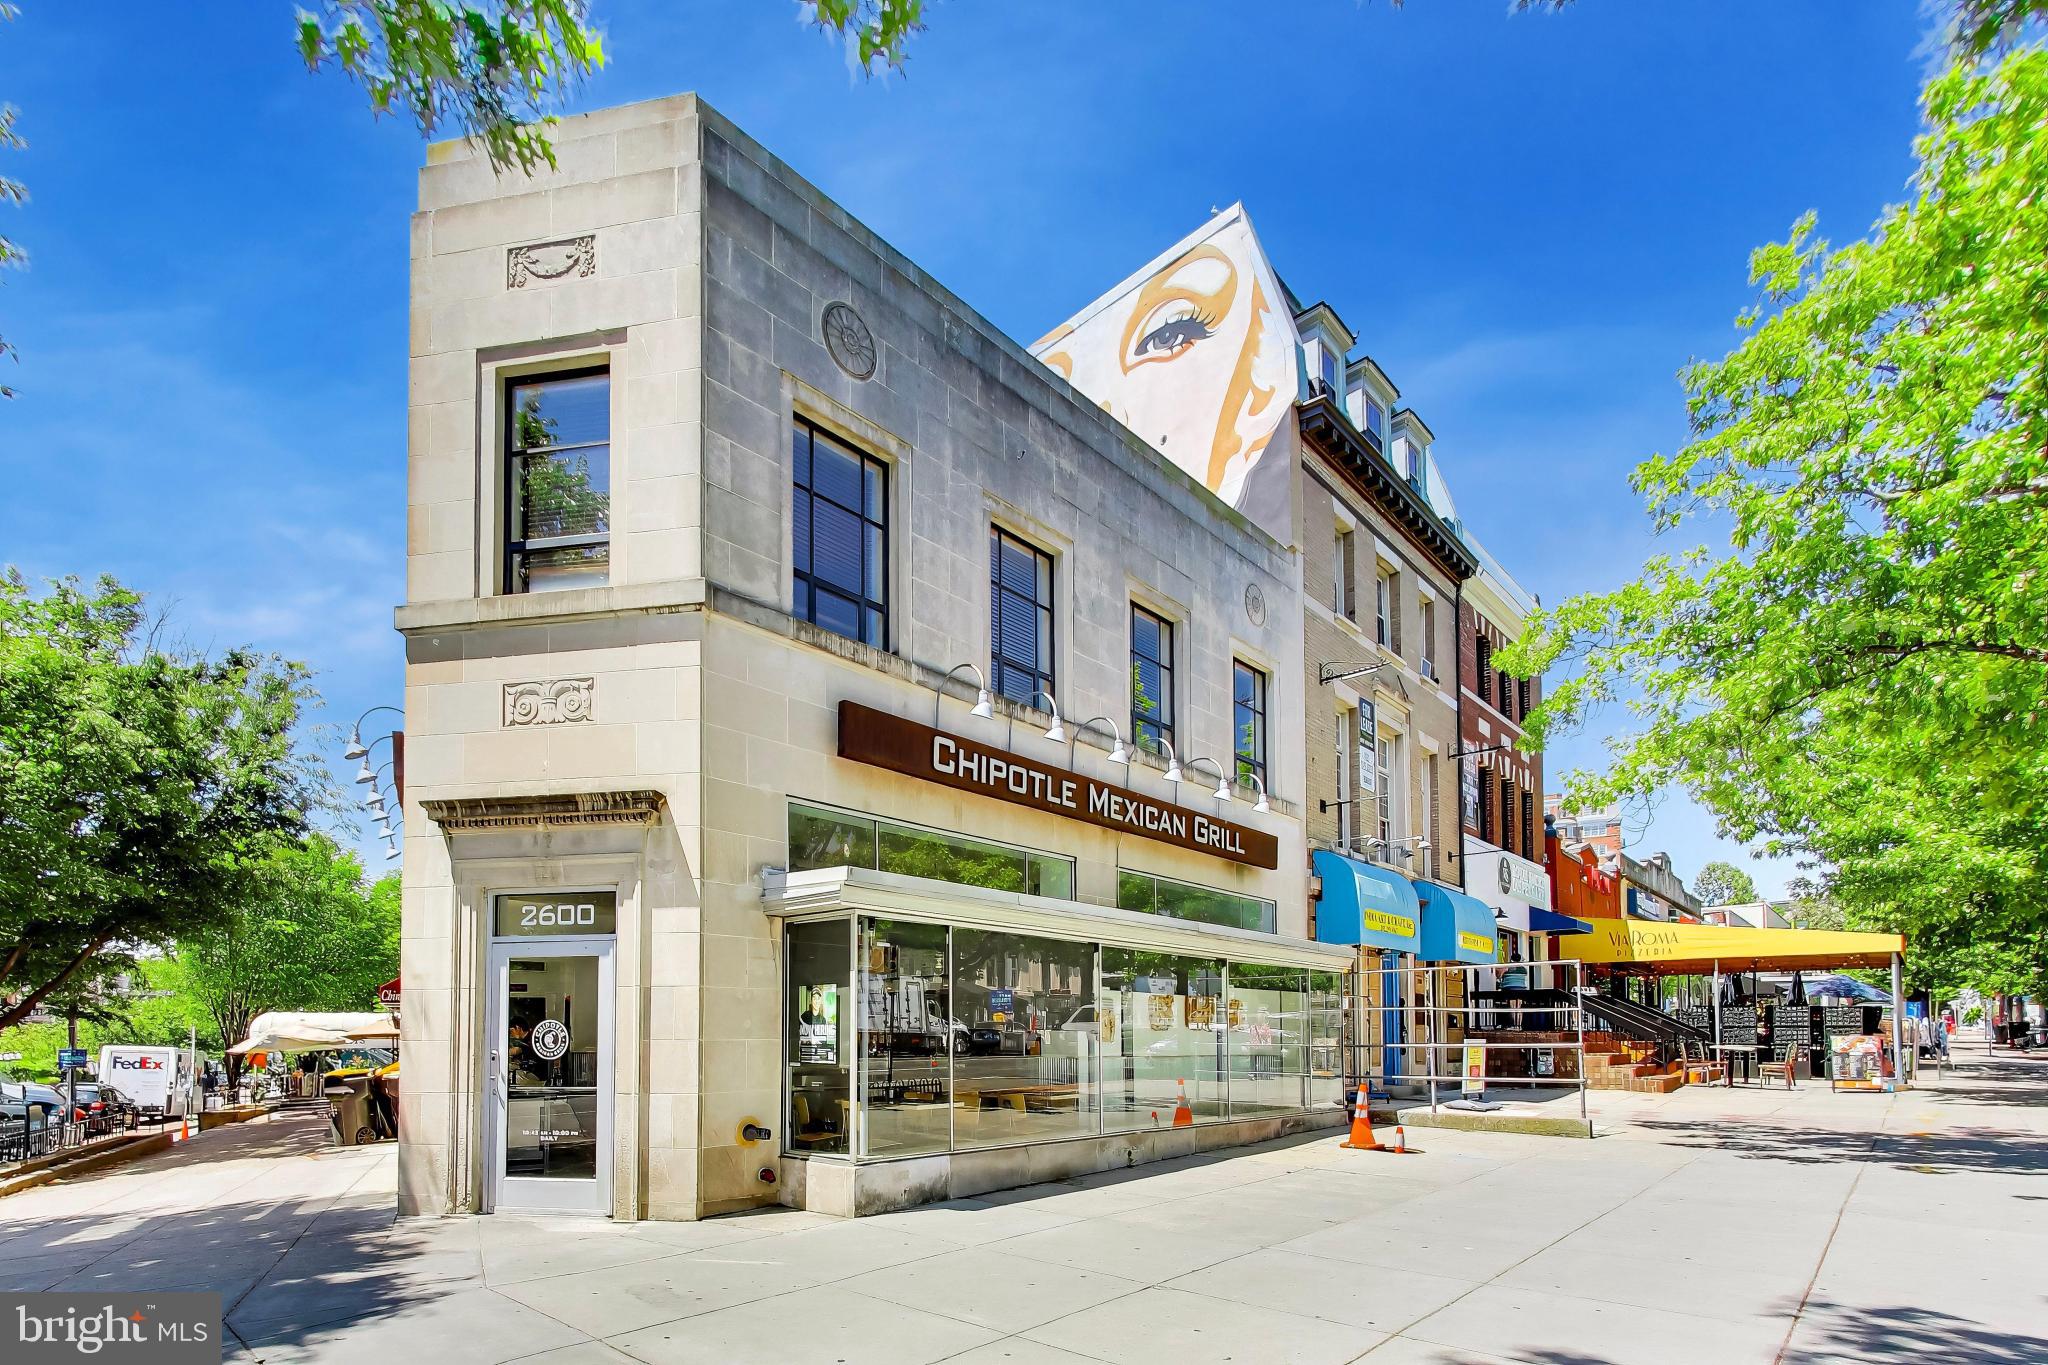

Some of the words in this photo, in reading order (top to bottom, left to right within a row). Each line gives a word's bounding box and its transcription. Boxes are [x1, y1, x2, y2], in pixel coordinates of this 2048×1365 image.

[933, 735, 1076, 809] CHIPOTLE
[1089, 783, 1186, 839] MEXICAN
[1194, 816, 1245, 855] GRILL
[520, 904, 595, 926] 2600
[1608, 930, 1629, 947] VIA
[1632, 930, 1679, 947] ROMA
[112, 1056, 163, 1070] FedEx
